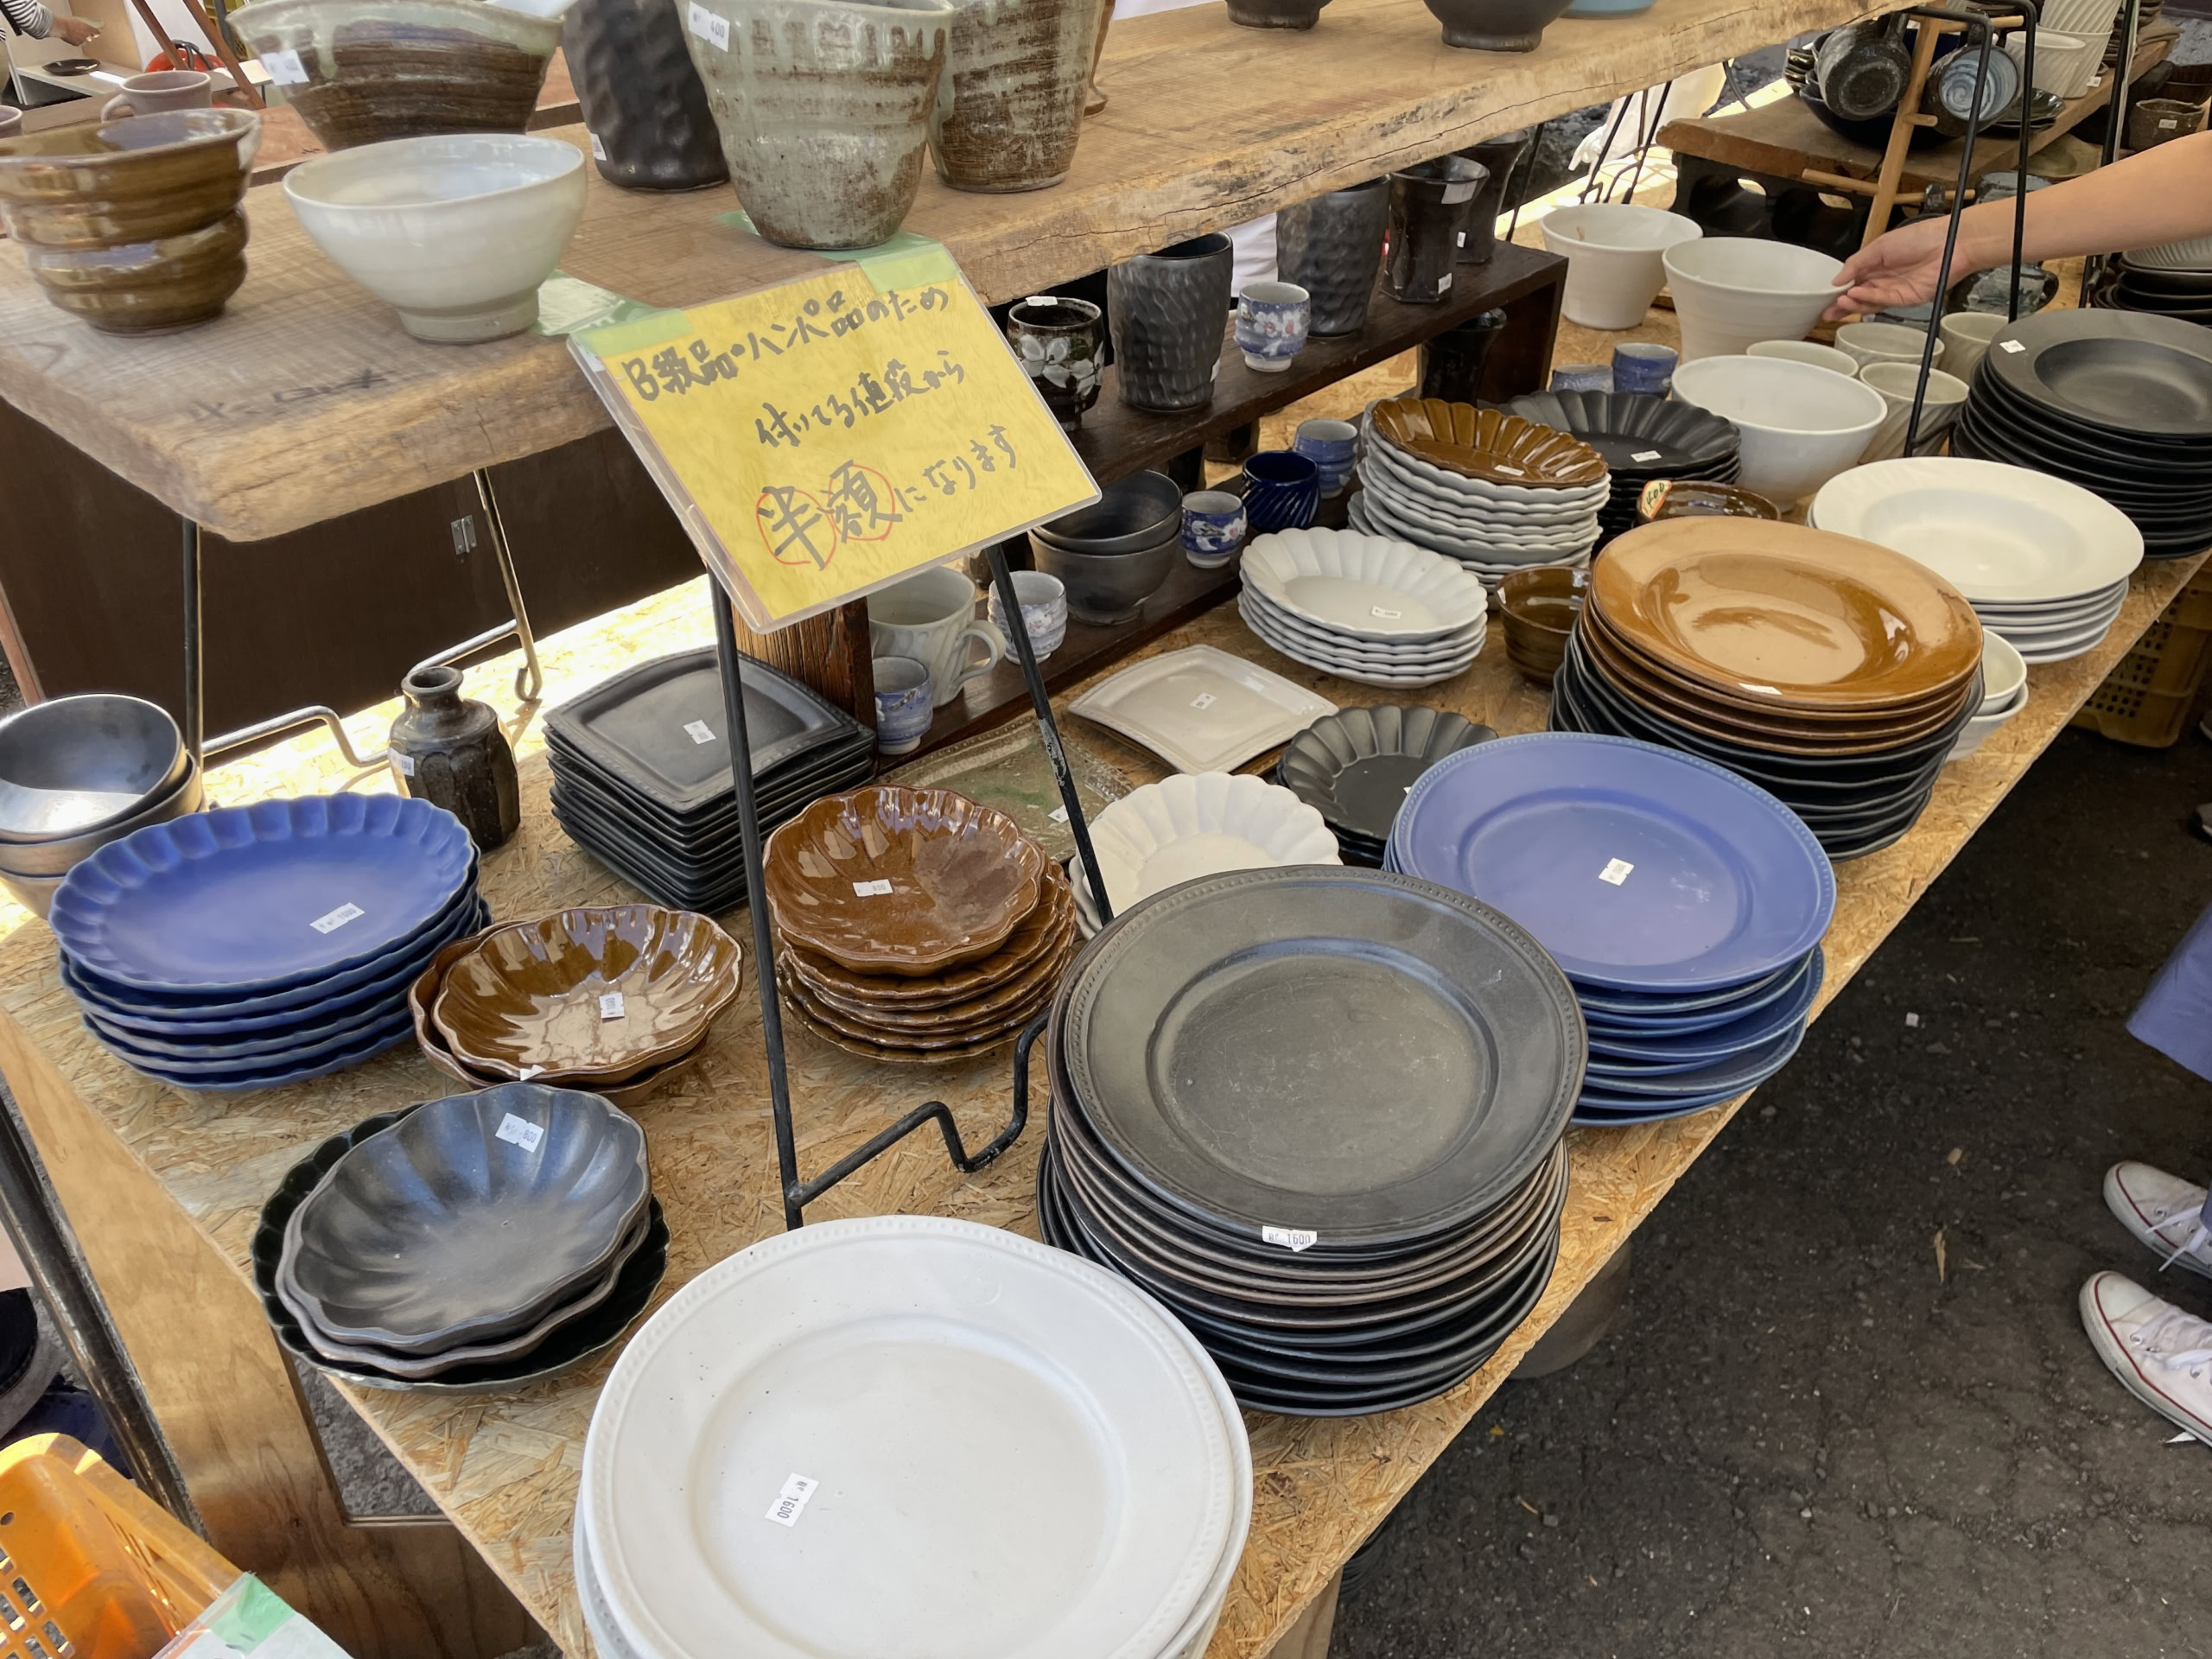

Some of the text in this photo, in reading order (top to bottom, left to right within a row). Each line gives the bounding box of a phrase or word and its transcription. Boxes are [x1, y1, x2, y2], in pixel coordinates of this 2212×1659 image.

[710, 21, 725, 38] 400
[755, 350, 965, 448] 付いてる値段から
[757, 424, 1016, 571] 半額になります
[523, 1129, 537, 1143] 800
[1287, 1233, 1311, 1245] 1600
[777, 1497, 799, 1519] 1600
